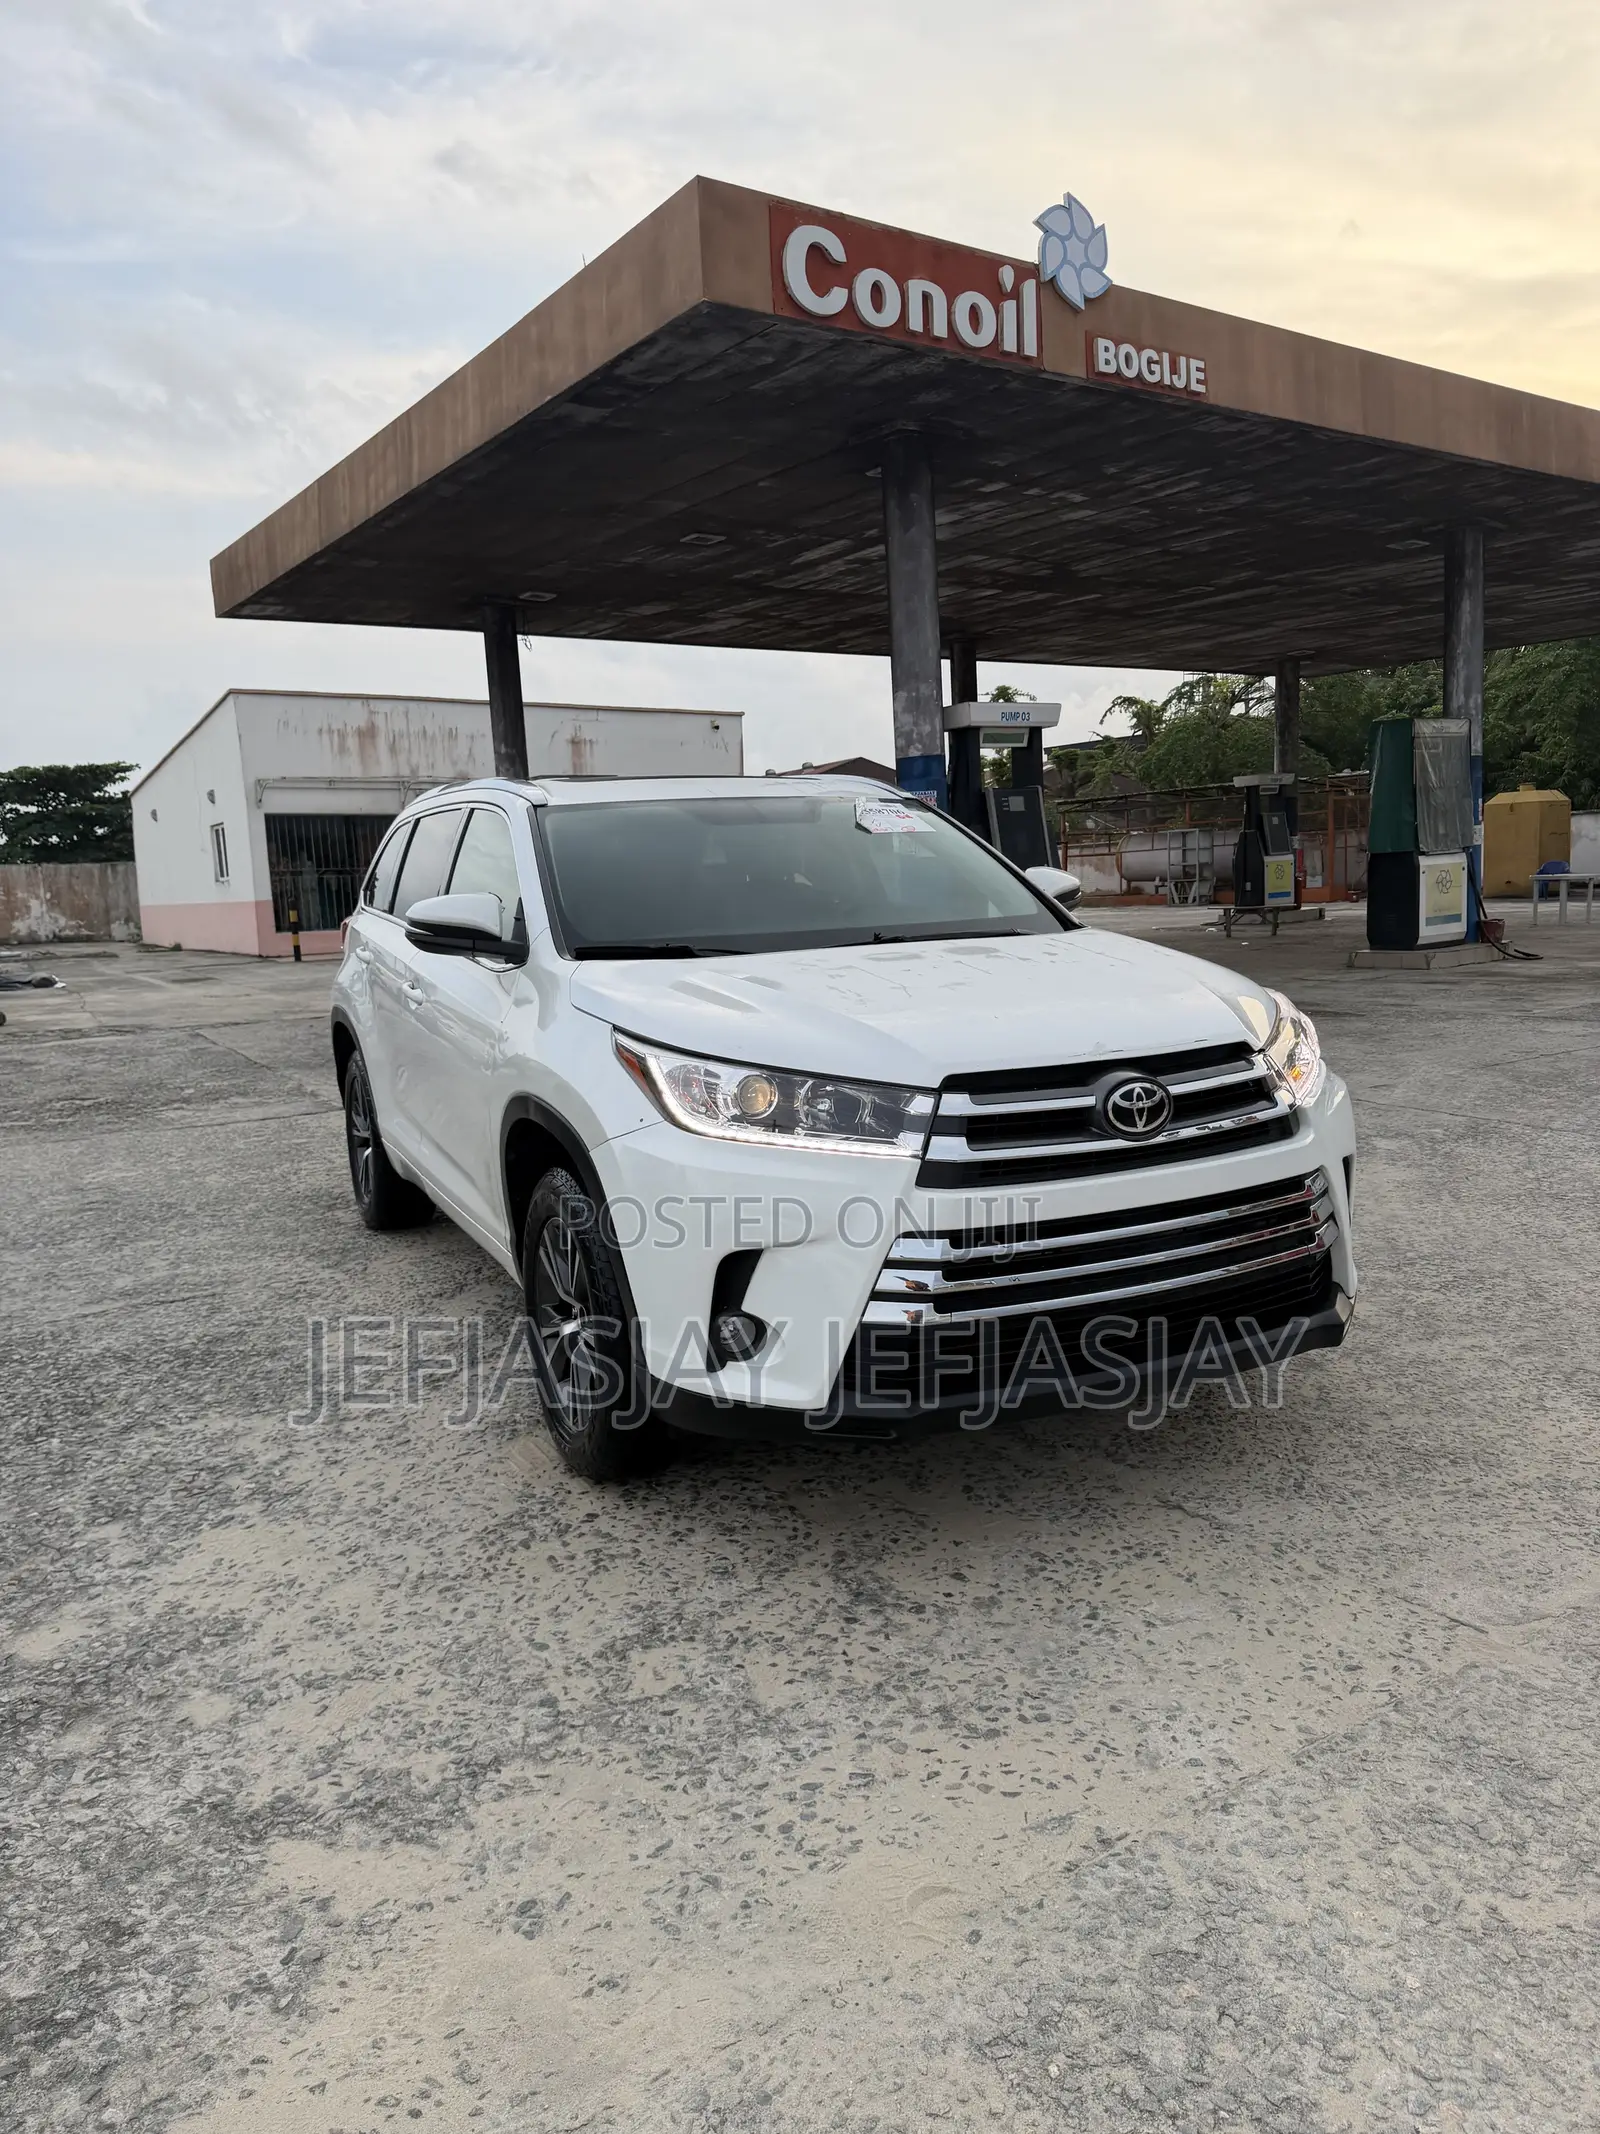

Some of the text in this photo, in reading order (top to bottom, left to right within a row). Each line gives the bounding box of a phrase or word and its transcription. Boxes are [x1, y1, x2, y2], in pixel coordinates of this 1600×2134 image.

[782, 224, 1039, 358] Conoil
[1093, 336, 1207, 393] BOGIJE
[1000, 711, 1031, 721] PUMP 03
